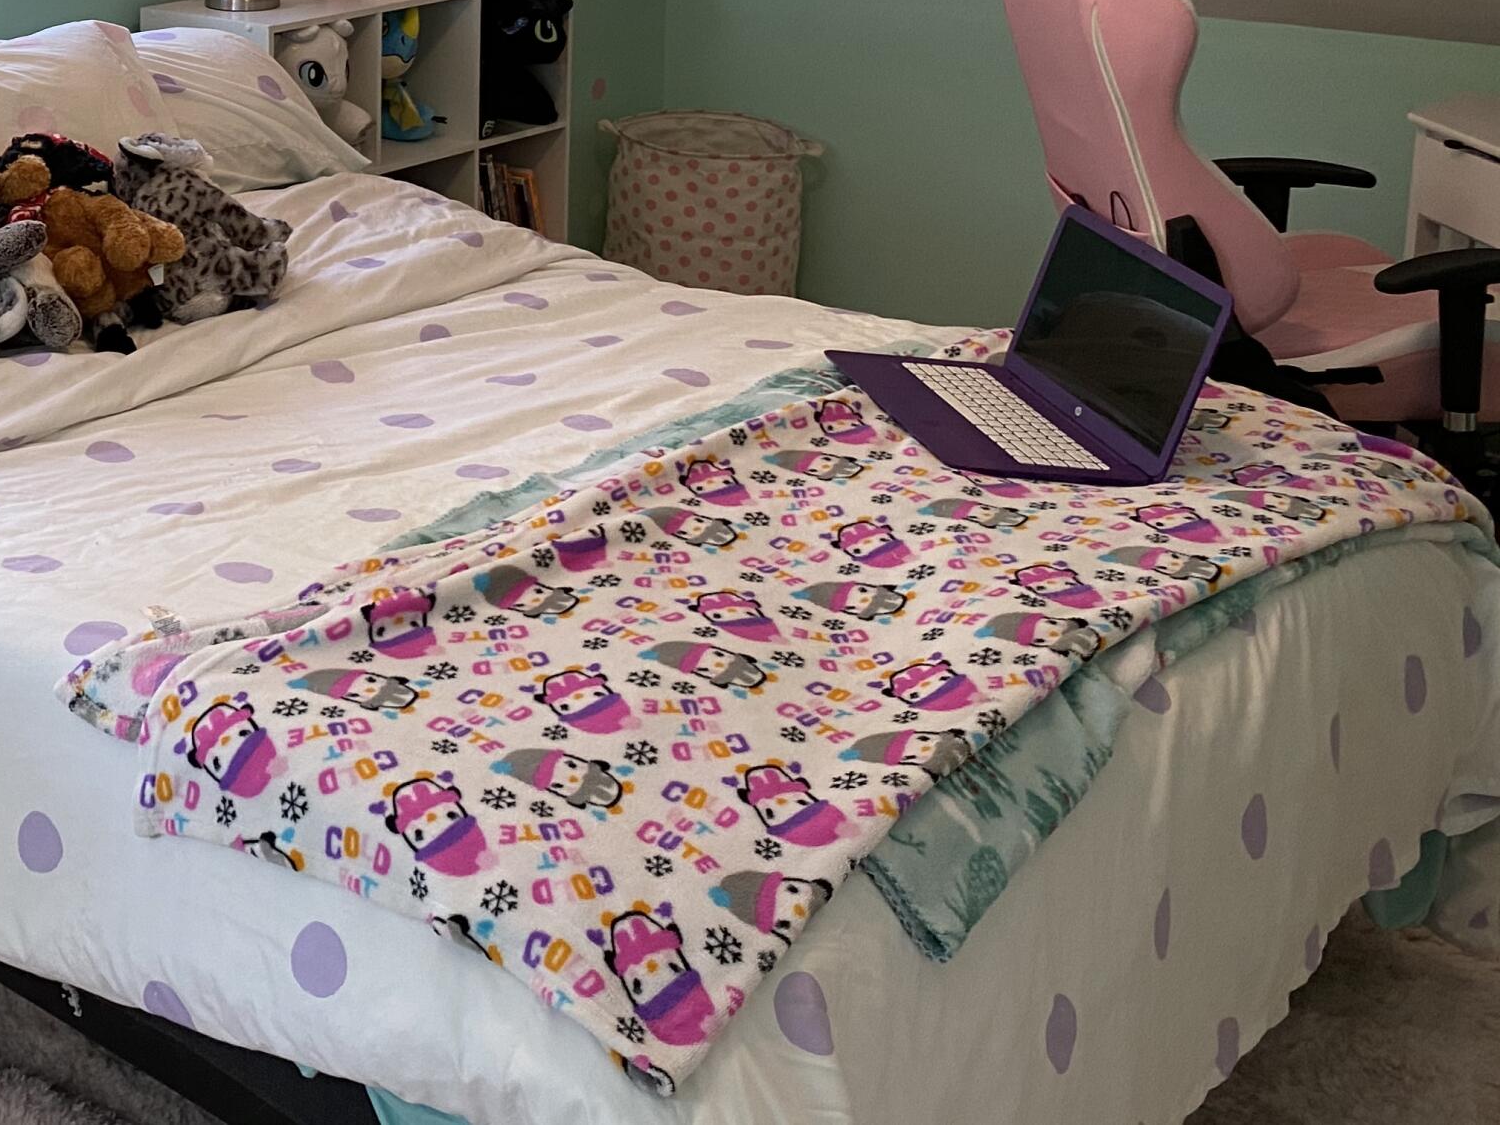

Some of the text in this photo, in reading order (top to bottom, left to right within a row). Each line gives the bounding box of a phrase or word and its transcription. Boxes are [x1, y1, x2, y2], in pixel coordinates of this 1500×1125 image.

[581, 618, 656, 646] CUTE
[916, 608, 988, 626] CUTE
[640, 696, 722, 717] CUTE
[287, 717, 373, 749] CUTE
[426, 716, 506, 753] CUTE
[776, 703, 855, 743] CUTE
[498, 818, 584, 845] CUTE
[636, 820, 721, 874] CUTE
